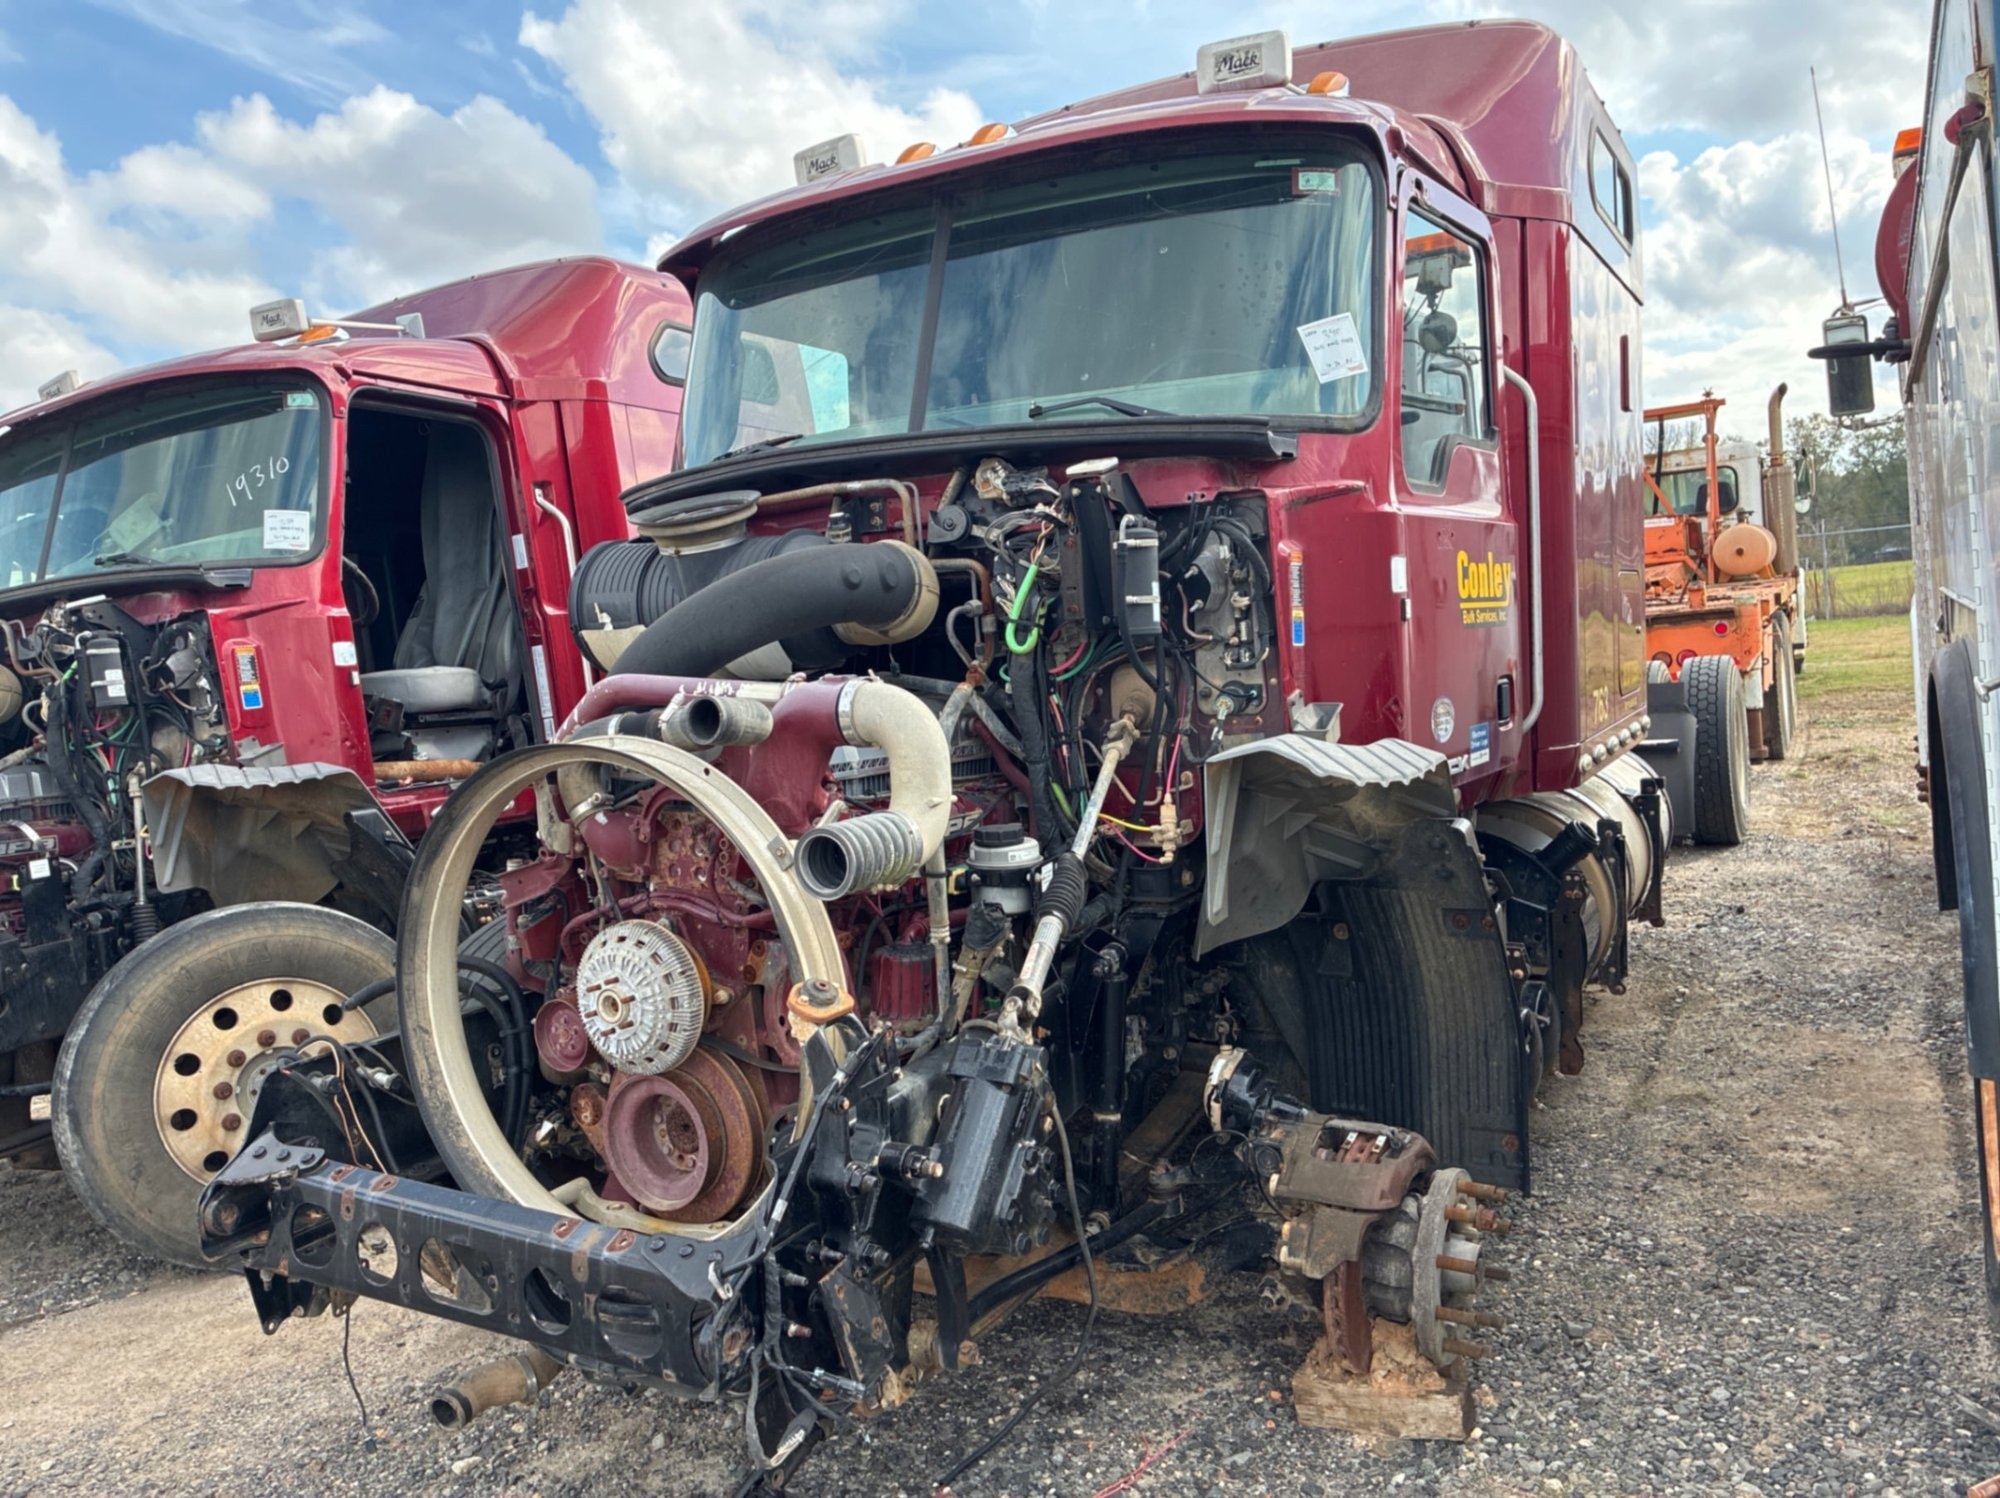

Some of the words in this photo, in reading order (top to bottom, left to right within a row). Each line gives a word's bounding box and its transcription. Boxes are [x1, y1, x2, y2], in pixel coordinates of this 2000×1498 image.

[1217, 51, 1261, 74] Mack
[807, 152, 839, 175] Mack
[260, 311, 282, 327] Mack
[225, 456, 290, 507] 19310
[1456, 550, 1511, 608] Conley
[1462, 609, 1476, 625] Bulk
